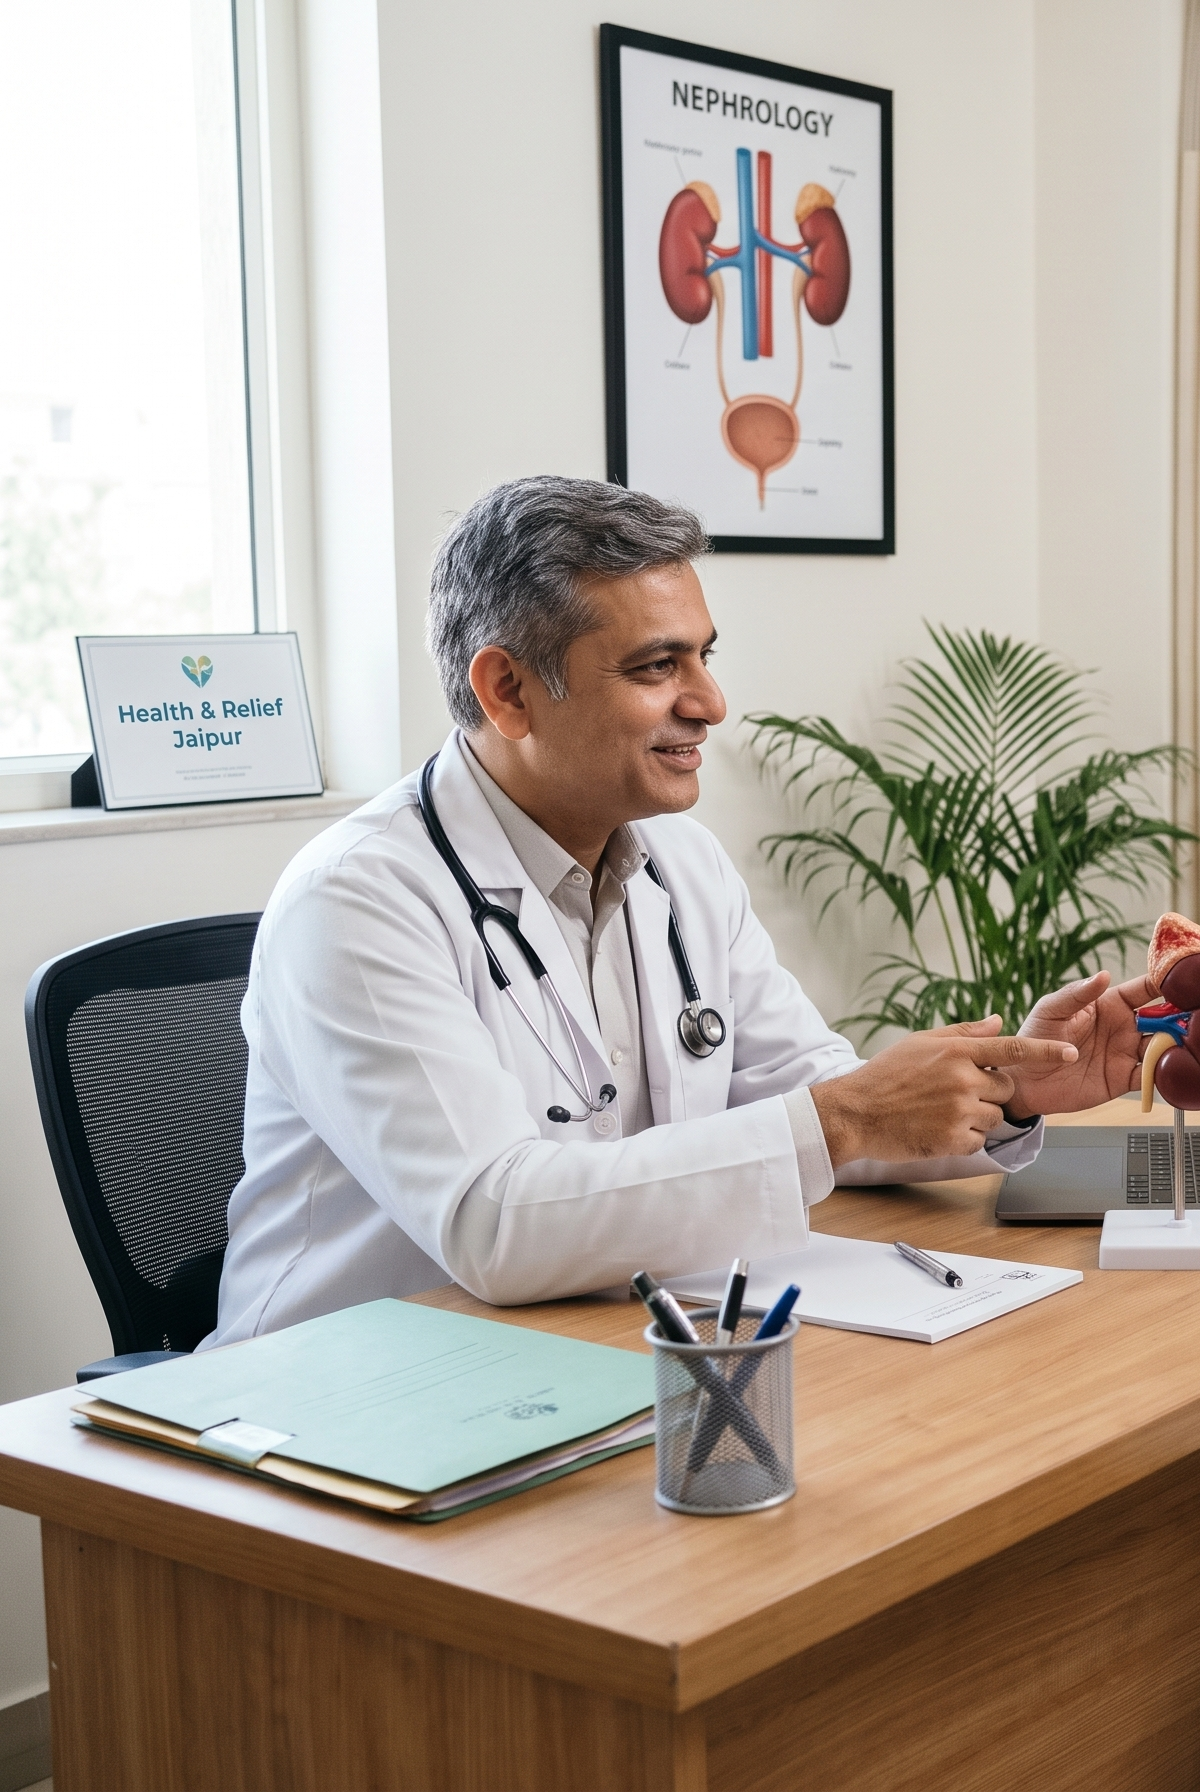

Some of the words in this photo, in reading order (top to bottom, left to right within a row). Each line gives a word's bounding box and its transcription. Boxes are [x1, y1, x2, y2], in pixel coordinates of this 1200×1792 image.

[672, 80, 834, 137] NEPHROLOGY
[118, 701, 194, 723] Health
[200, 700, 217, 719] &
[221, 697, 284, 719] Relief
[172, 727, 243, 752] Jaipur
